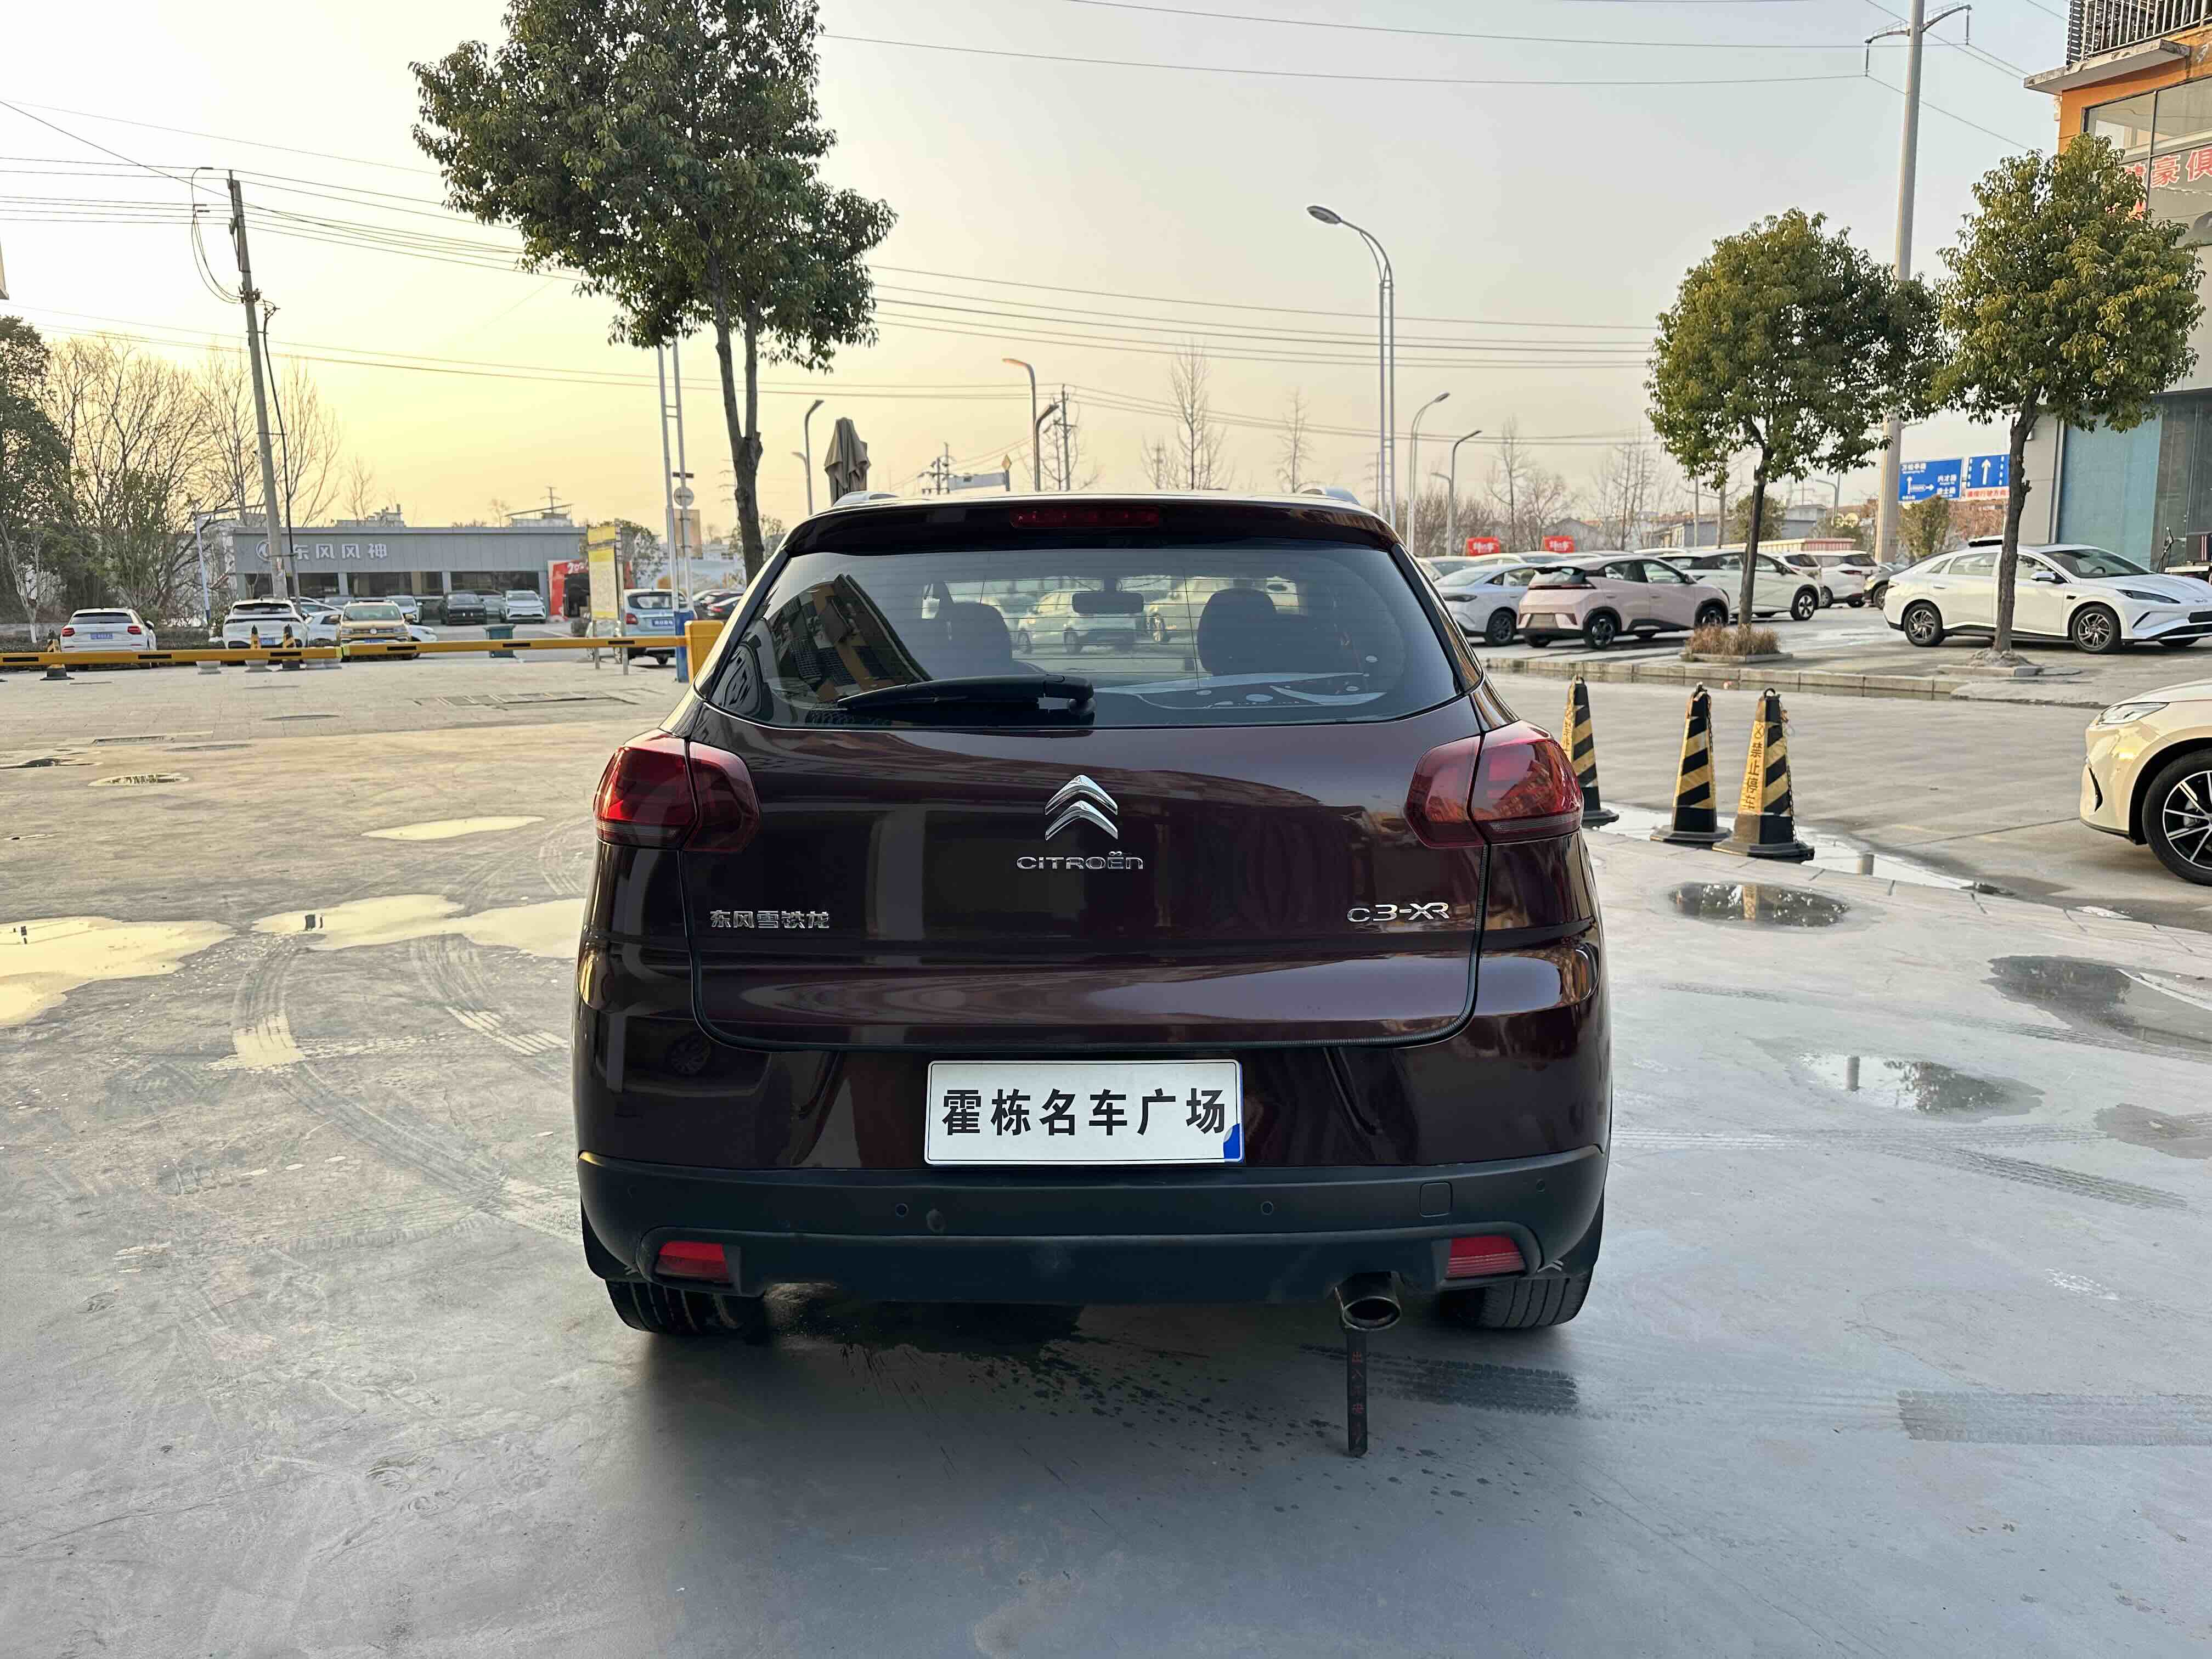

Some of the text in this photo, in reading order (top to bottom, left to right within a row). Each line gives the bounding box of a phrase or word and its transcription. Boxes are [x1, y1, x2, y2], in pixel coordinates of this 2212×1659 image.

[2125, 146, 2211, 189] 豪俱
[292, 543, 387, 560] 东风风神
[709, 910, 830, 929] 东风雪铁龙
[1347, 902, 1450, 922] C3-XR
[941, 1087, 1225, 1136] 霍栋名车广场
